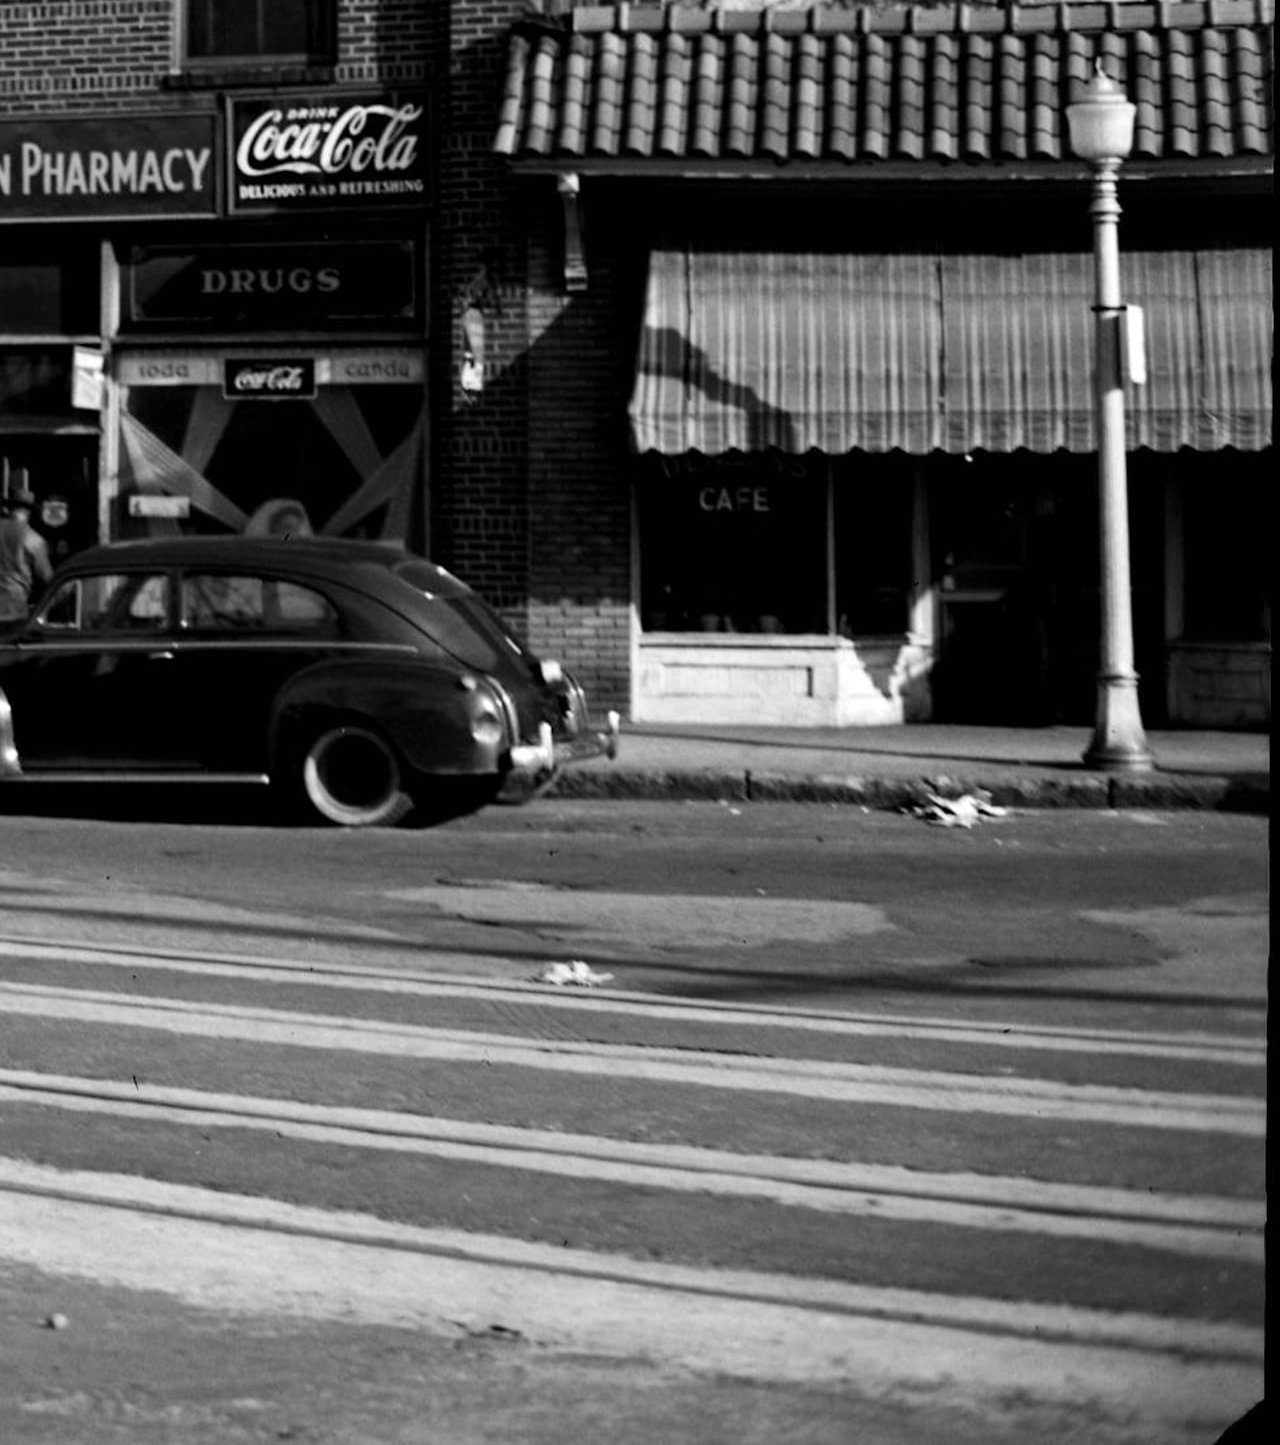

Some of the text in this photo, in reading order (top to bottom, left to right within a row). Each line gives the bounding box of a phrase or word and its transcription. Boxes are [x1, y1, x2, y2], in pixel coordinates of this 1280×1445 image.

[287, 107, 339, 120] DRINK
[237, 103, 423, 177] Coca-Cola
[22, 142, 210, 196] PHARMACY
[239, 179, 424, 200] DELICIOUS AND REFRESHING
[201, 267, 341, 293] DRUGS
[139, 363, 189, 379] soda
[345, 362, 410, 380] candy
[698, 487, 770, 512] CAFE
